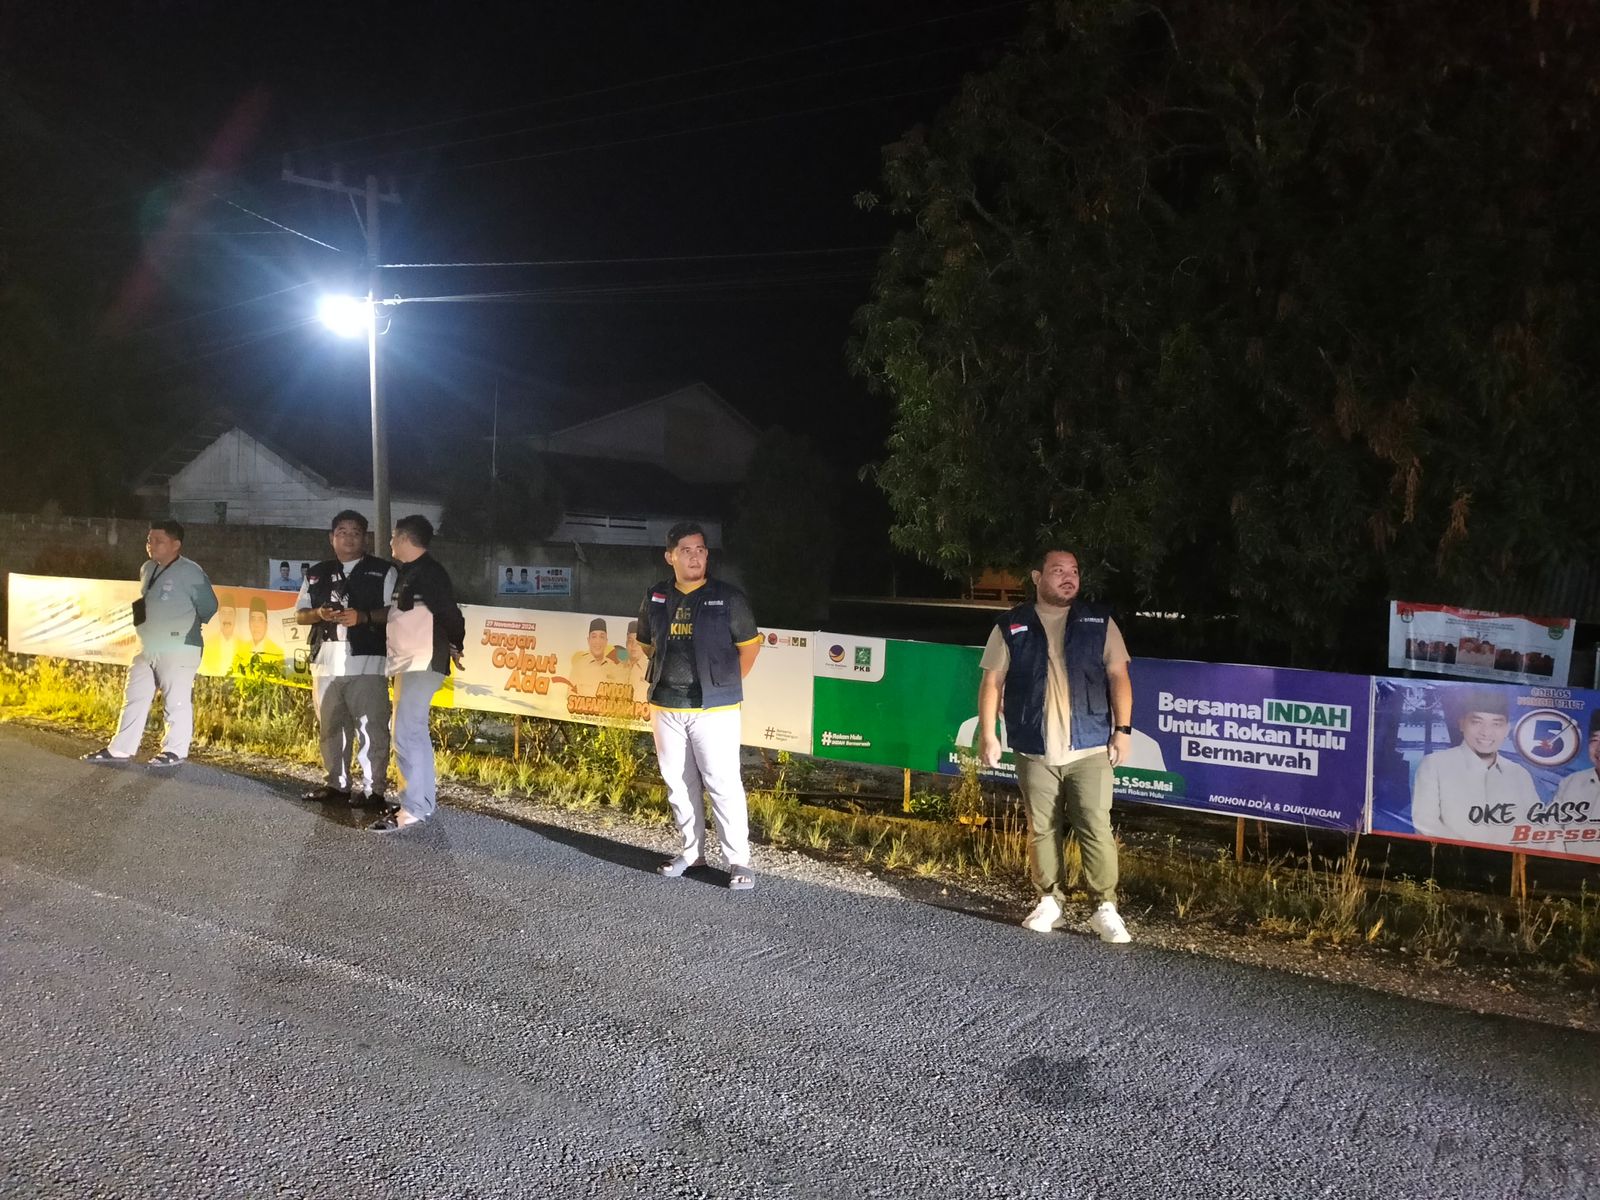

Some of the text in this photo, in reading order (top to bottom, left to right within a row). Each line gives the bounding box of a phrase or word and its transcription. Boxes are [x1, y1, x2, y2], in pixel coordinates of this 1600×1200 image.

[290, 627, 299, 639] 2
[481, 629, 536, 651] Jangan
[504, 670, 551, 695] Ada
[1531, 687, 1571, 699] COBLOS
[1158, 691, 1347, 728] Bersama INDAH
[1158, 714, 1346, 750] Untuk Rokan Hulu
[1530, 719, 1565, 758] 5
[1187, 740, 1311, 770] Bermarwah
[1208, 794, 1341, 820] MOHON DO'A & DUKUNGAN
[1468, 803, 1516, 824] OKE
